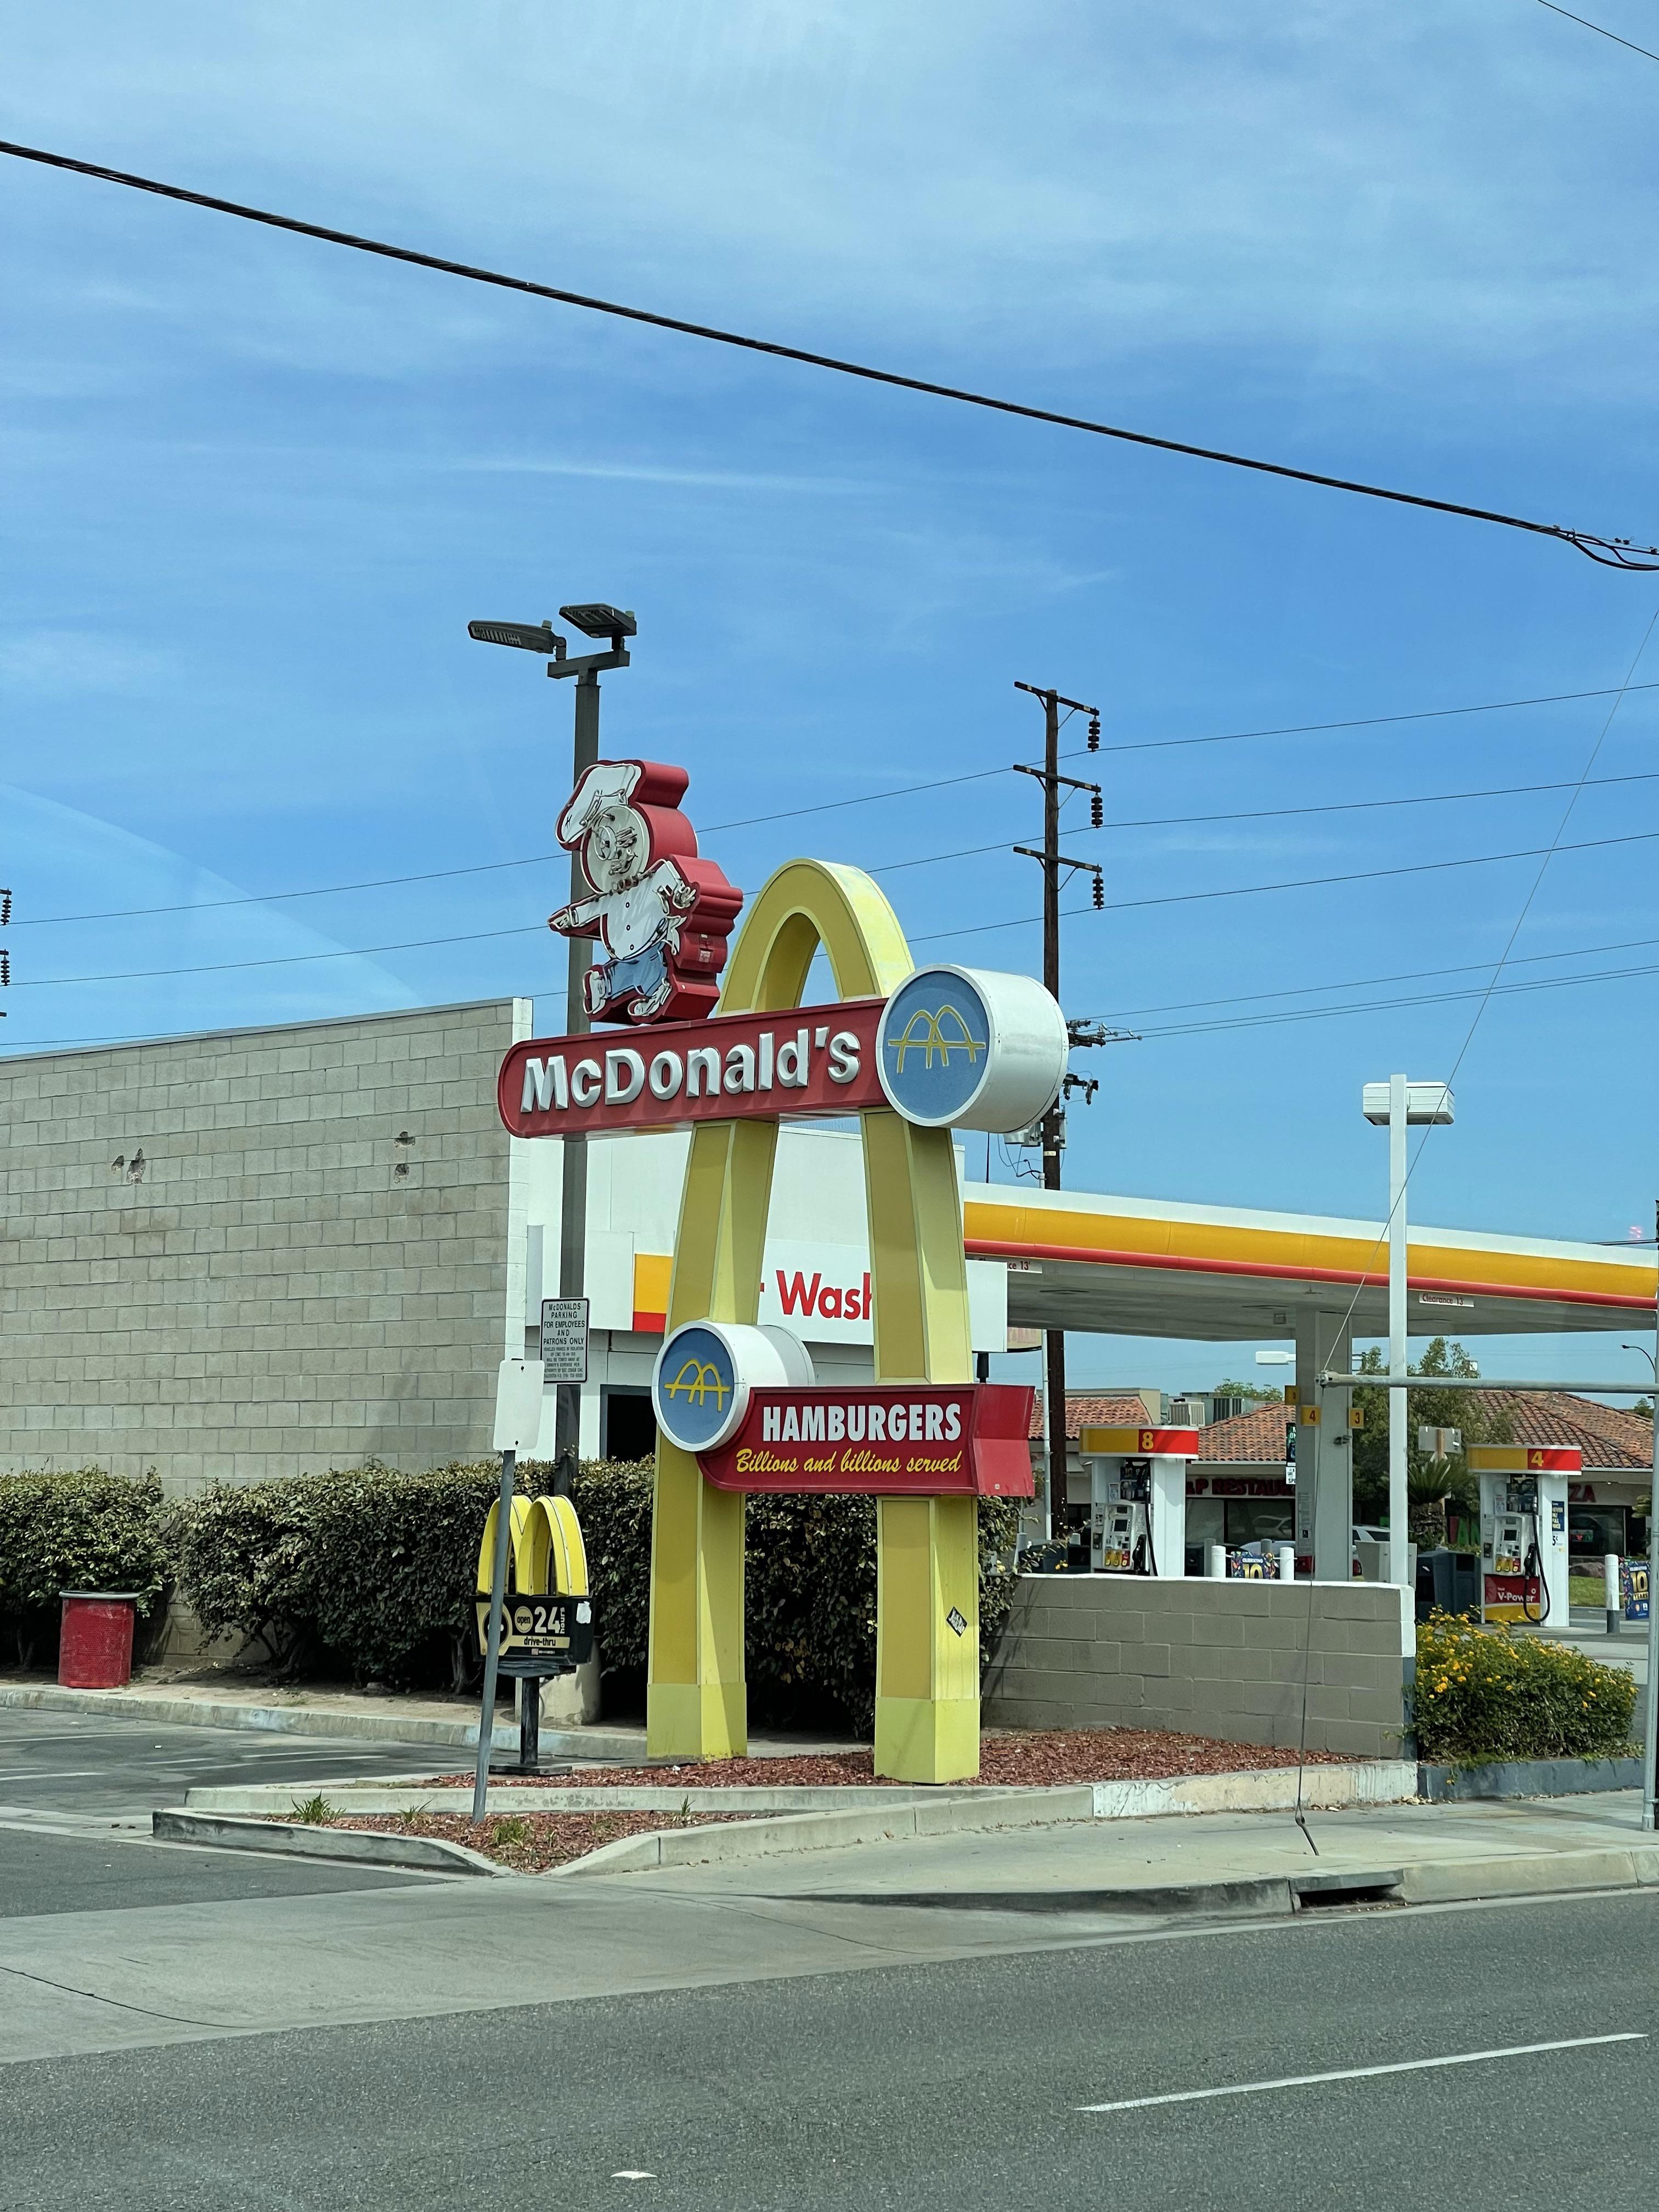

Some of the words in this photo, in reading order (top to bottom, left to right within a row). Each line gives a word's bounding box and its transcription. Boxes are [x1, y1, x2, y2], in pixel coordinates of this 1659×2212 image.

[520, 1026, 861, 1113] McDonald's
[1422, 1293, 1453, 1304] Clearance
[549, 1302, 581, 1311] McDONALDS
[763, 1403, 961, 1442] HAMBURGERS
[1310, 1409, 1316, 1422] 4
[1355, 1412, 1360, 1424] 3
[1142, 1431, 1154, 1450] 8
[736, 1448, 799, 1472] Billions
[804, 1451, 837, 1472] and
[840, 1448, 901, 1473] billions
[906, 1450, 963, 1473] served
[1531, 1451, 1544, 1466] 4
[1212, 1479, 1295, 1496] RESTAUR
[1243, 1563, 1263, 1578] 10
[1630, 1571, 1648, 1593] 10
[1498, 1592, 1534, 1602] V-Power
[517, 1616, 531, 1626] open
[534, 1606, 560, 1634] 24
[524, 1637, 556, 1646] drive-thru
